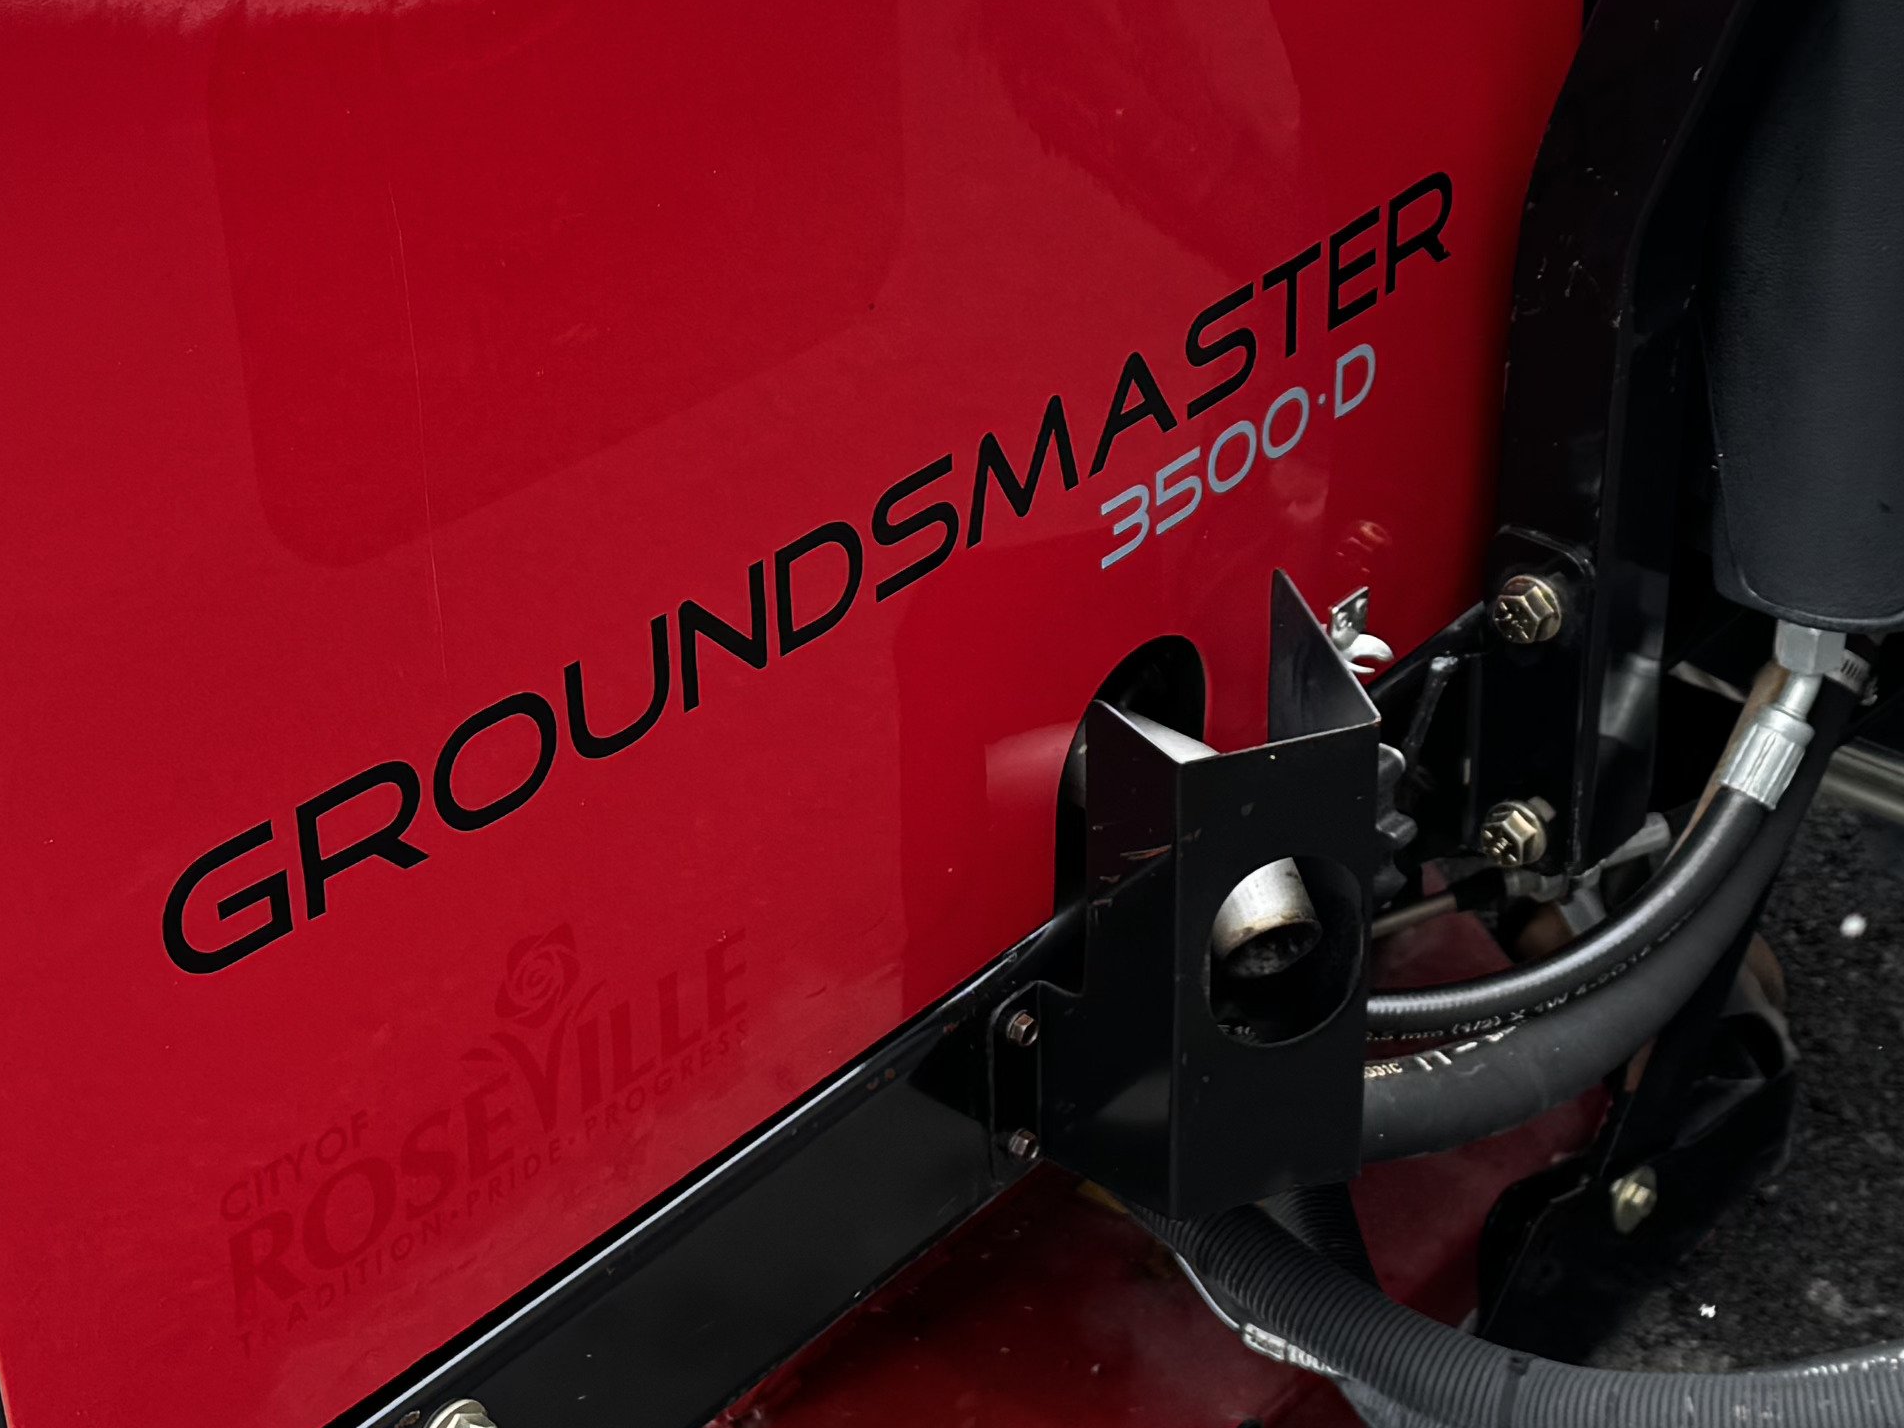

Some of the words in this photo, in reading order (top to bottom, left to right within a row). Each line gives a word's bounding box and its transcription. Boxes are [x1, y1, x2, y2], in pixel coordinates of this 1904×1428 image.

[162, 170, 1454, 975] GROUNDSMASTER
[219, 1142, 308, 1222] CITY
[315, 1109, 370, 1166] OF
[227, 926, 749, 1329] ROSEVILLE
